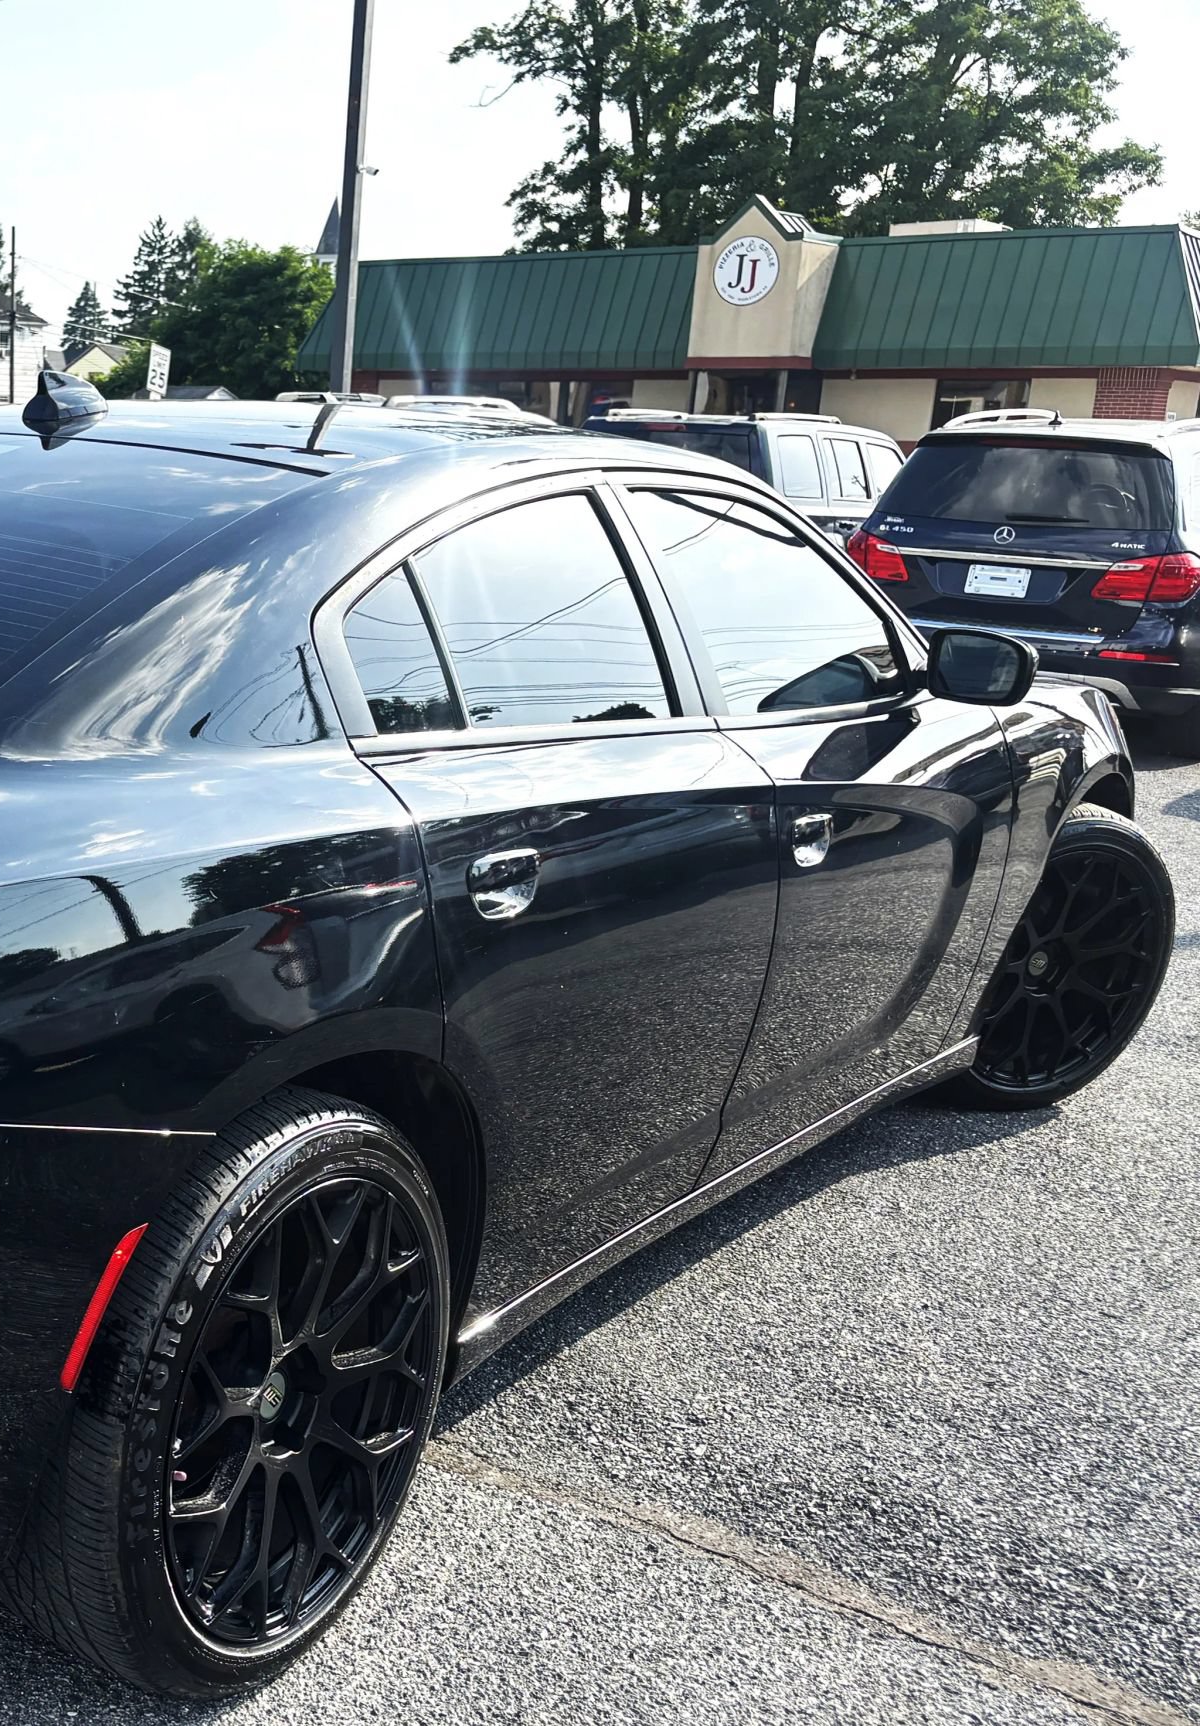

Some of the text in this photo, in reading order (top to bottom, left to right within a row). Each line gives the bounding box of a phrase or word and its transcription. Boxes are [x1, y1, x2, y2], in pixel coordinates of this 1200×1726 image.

[718, 241, 745, 270] PIZZERIA
[759, 243, 776, 268] GRILLE
[727, 253, 761, 293] JJ
[149, 369, 166, 389] 25
[239, 1135, 332, 1217] FIREHAWK
